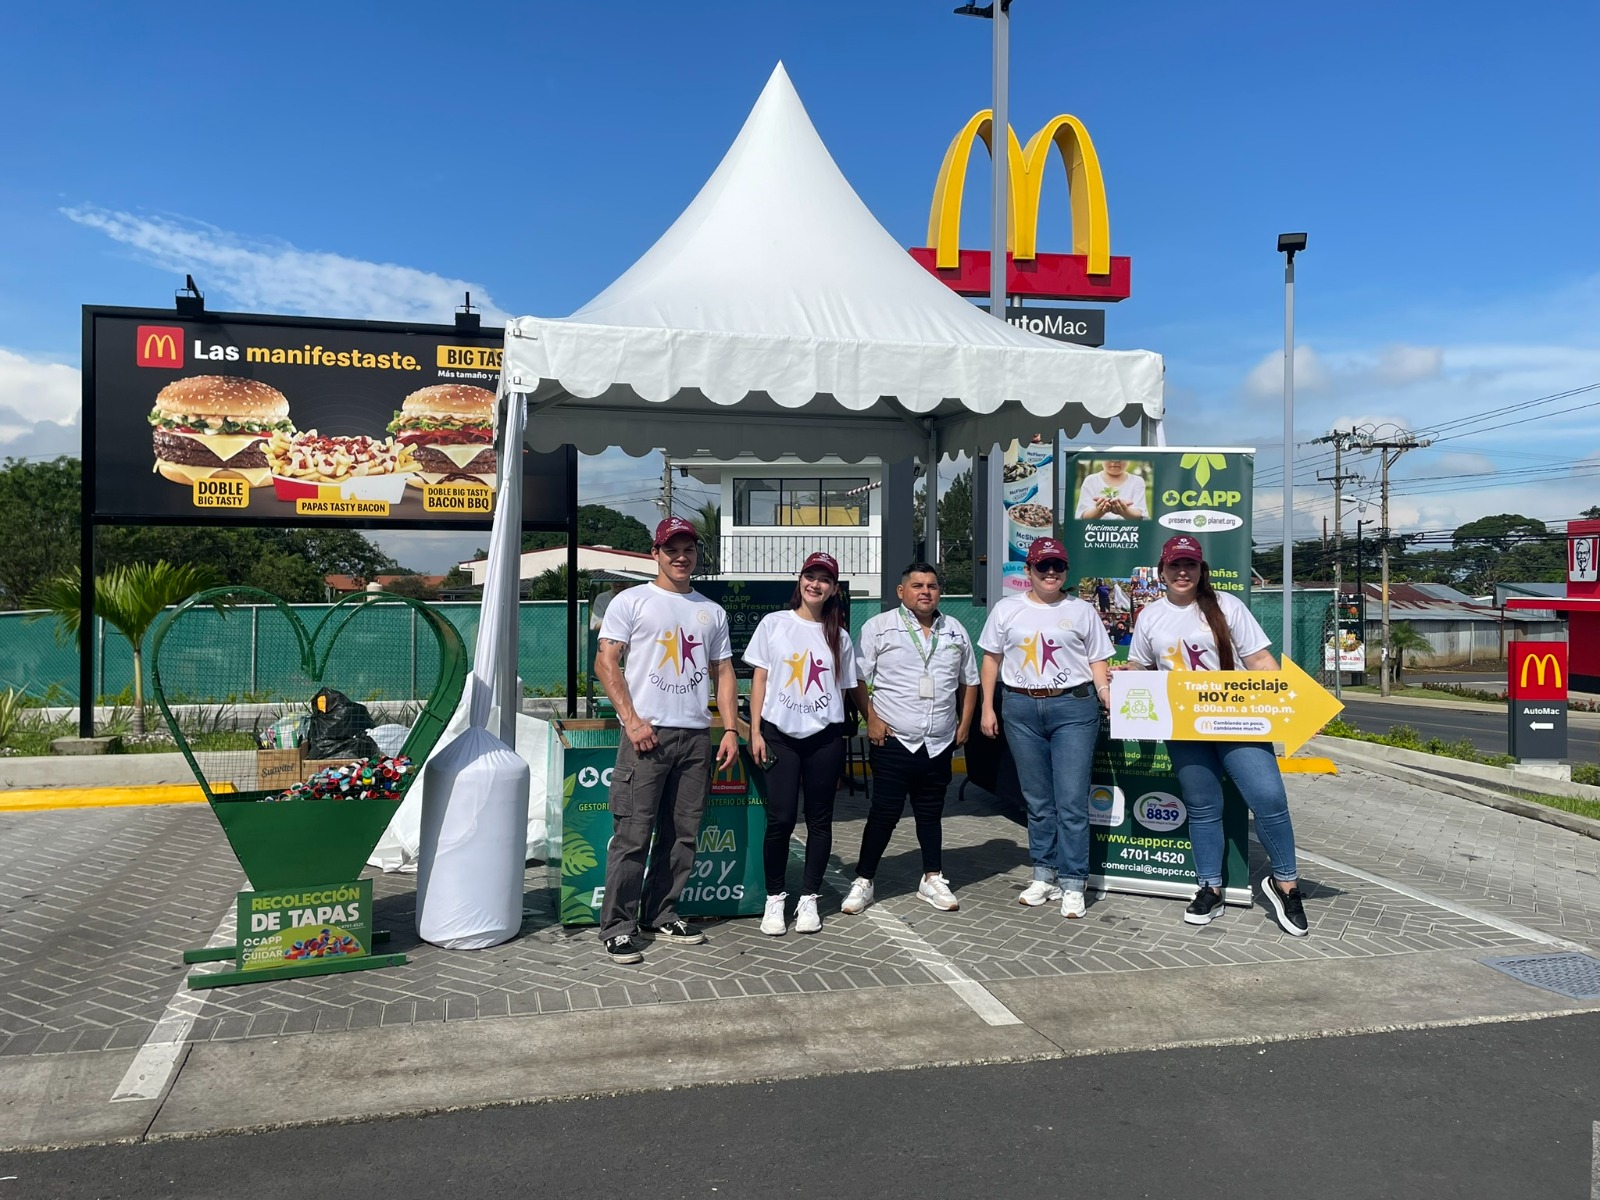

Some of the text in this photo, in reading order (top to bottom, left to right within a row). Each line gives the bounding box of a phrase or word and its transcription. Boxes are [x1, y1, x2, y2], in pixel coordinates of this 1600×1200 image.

[194, 340, 422, 371] Las manifestaste.
[447, 349, 504, 367] BIG TAS
[437, 370, 455, 378] Más
[456, 371, 487, 380] tamaño
[198, 481, 243, 496] DOBLE
[428, 488, 489, 497] DOBLE BIG TASTY
[198, 496, 243, 506] BIG TASTY
[428, 497, 489, 510] BACON BBQ
[302, 502, 386, 513] PAPAS TASTY BACON
[1168, 517, 1236, 526] preserve planet.org
[1085, 523, 1139, 533] Nacimos para
[1016, 531, 1040, 541] McSha
[1084, 531, 1139, 542] CUIDAR
[1012, 579, 1023, 587] en
[1210, 582, 1245, 591] ntales
[741, 602, 781, 610] Preserve
[1184, 678, 1289, 694] Traé tu reciclaje
[1198, 691, 1245, 702] HOY de
[1193, 704, 1239, 713] 8:00a.m.
[1249, 704, 1296, 715] 1:00p.m.
[1523, 707, 1560, 715] AutoMac
[1143, 753, 1171, 762] estraté
[261, 762, 295, 779] Suavitel
[1167, 763, 1173, 771] y
[706, 797, 735, 806] ISTERIO
[1146, 808, 1179, 821] 8839
[1096, 833, 1192, 849] www.cappcr.co
[1120, 848, 1185, 864] 4701-4520
[717, 860, 737, 884] y
[1101, 861, 1197, 877] comercial@cappcr.co
[251, 885, 360, 911] RECOLECCIÓN
[251, 902, 360, 933] DE TAPAS
[242, 949, 283, 961] CUIDAR
